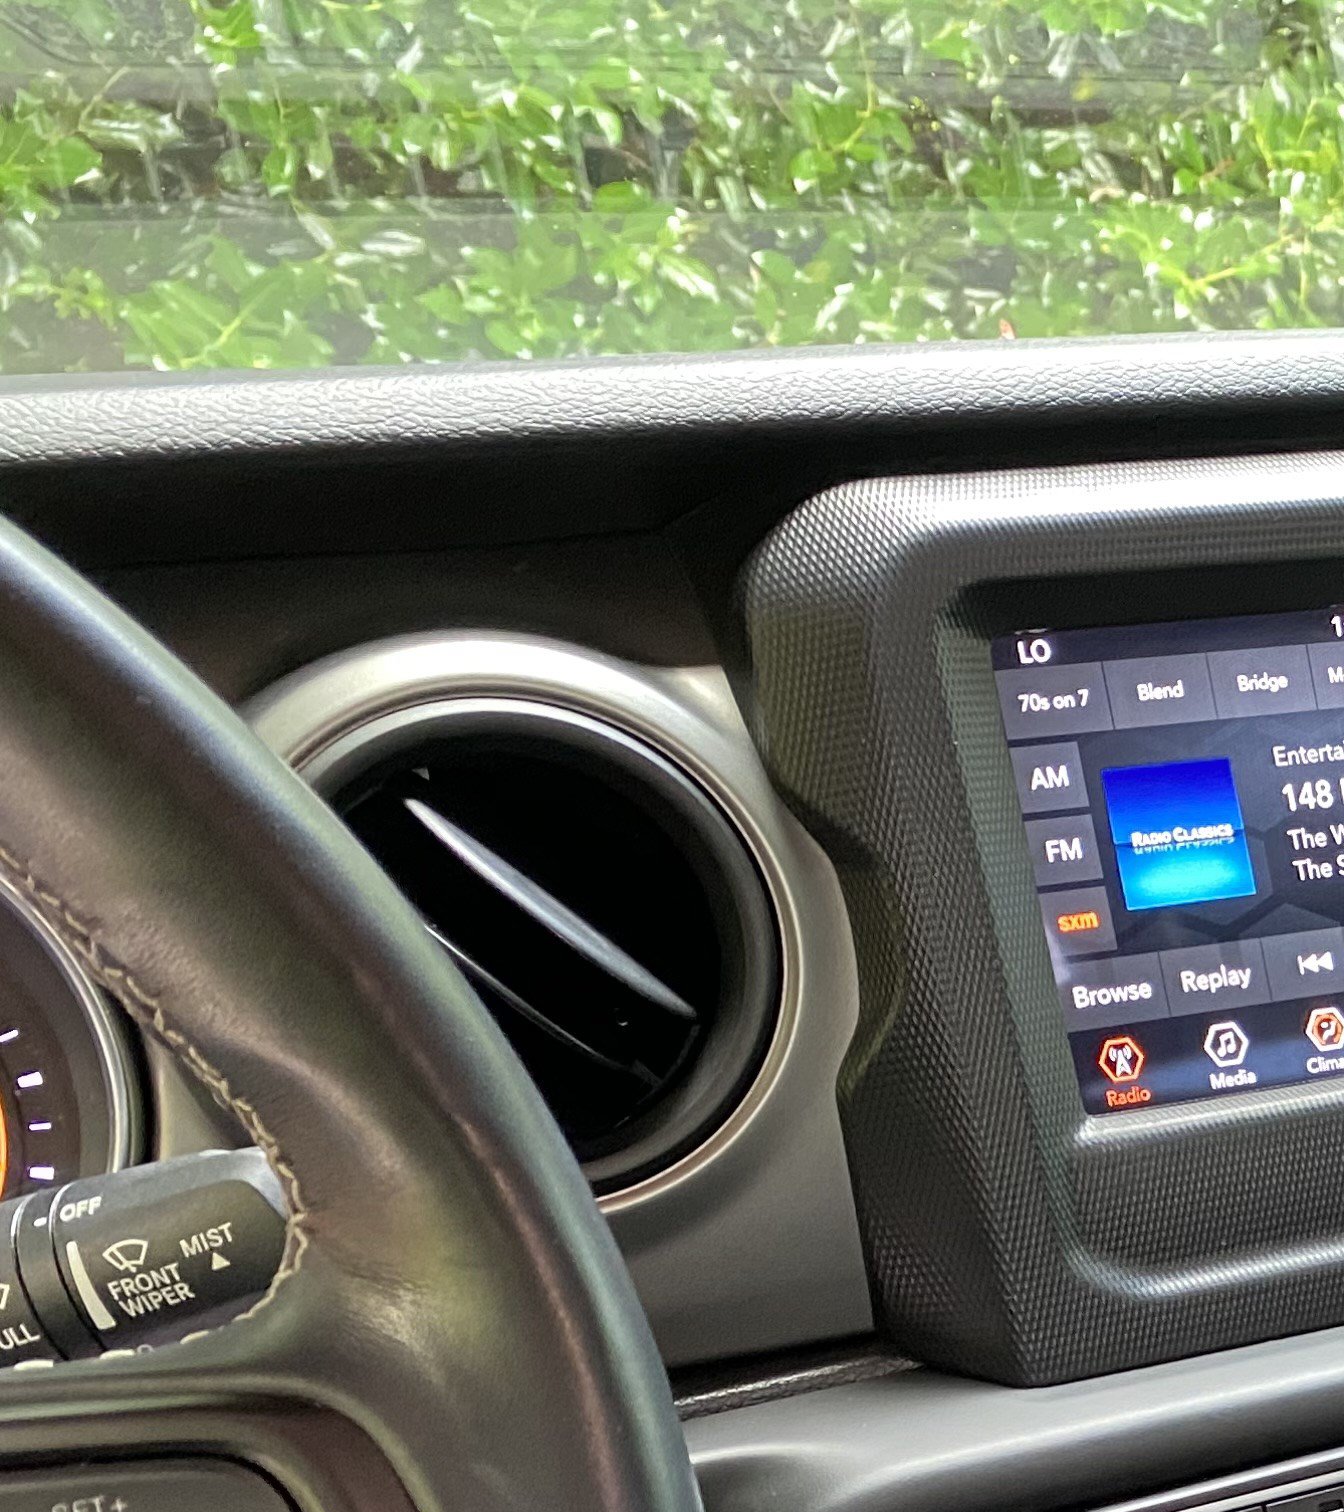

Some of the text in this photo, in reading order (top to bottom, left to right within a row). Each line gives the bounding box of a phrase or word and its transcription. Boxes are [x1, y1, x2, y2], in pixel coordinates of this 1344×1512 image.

[1016, 638, 1052, 665] LO
[1137, 678, 1185, 702] Blend
[1236, 671, 1289, 693] Bridge
[1017, 688, 1089, 714] 70s on 7
[1030, 765, 1070, 791] AM
[1282, 779, 1334, 812] 148
[1046, 836, 1084, 863] FM
[1286, 827, 1328, 851] The
[1292, 857, 1333, 881] The
[1057, 910, 1099, 933] sxm
[1180, 964, 1252, 994] Replay
[1072, 981, 1153, 1010] Browse
[1209, 1069, 1257, 1090] Media
[1105, 1086, 1152, 1107] Radio
[59, 1195, 102, 1222] OFF
[179, 1222, 234, 1259] MIST
[107, 1263, 182, 1301] FRONT
[119, 1282, 196, 1318] WIPER
[0, 1323, 41, 1350] ULL
